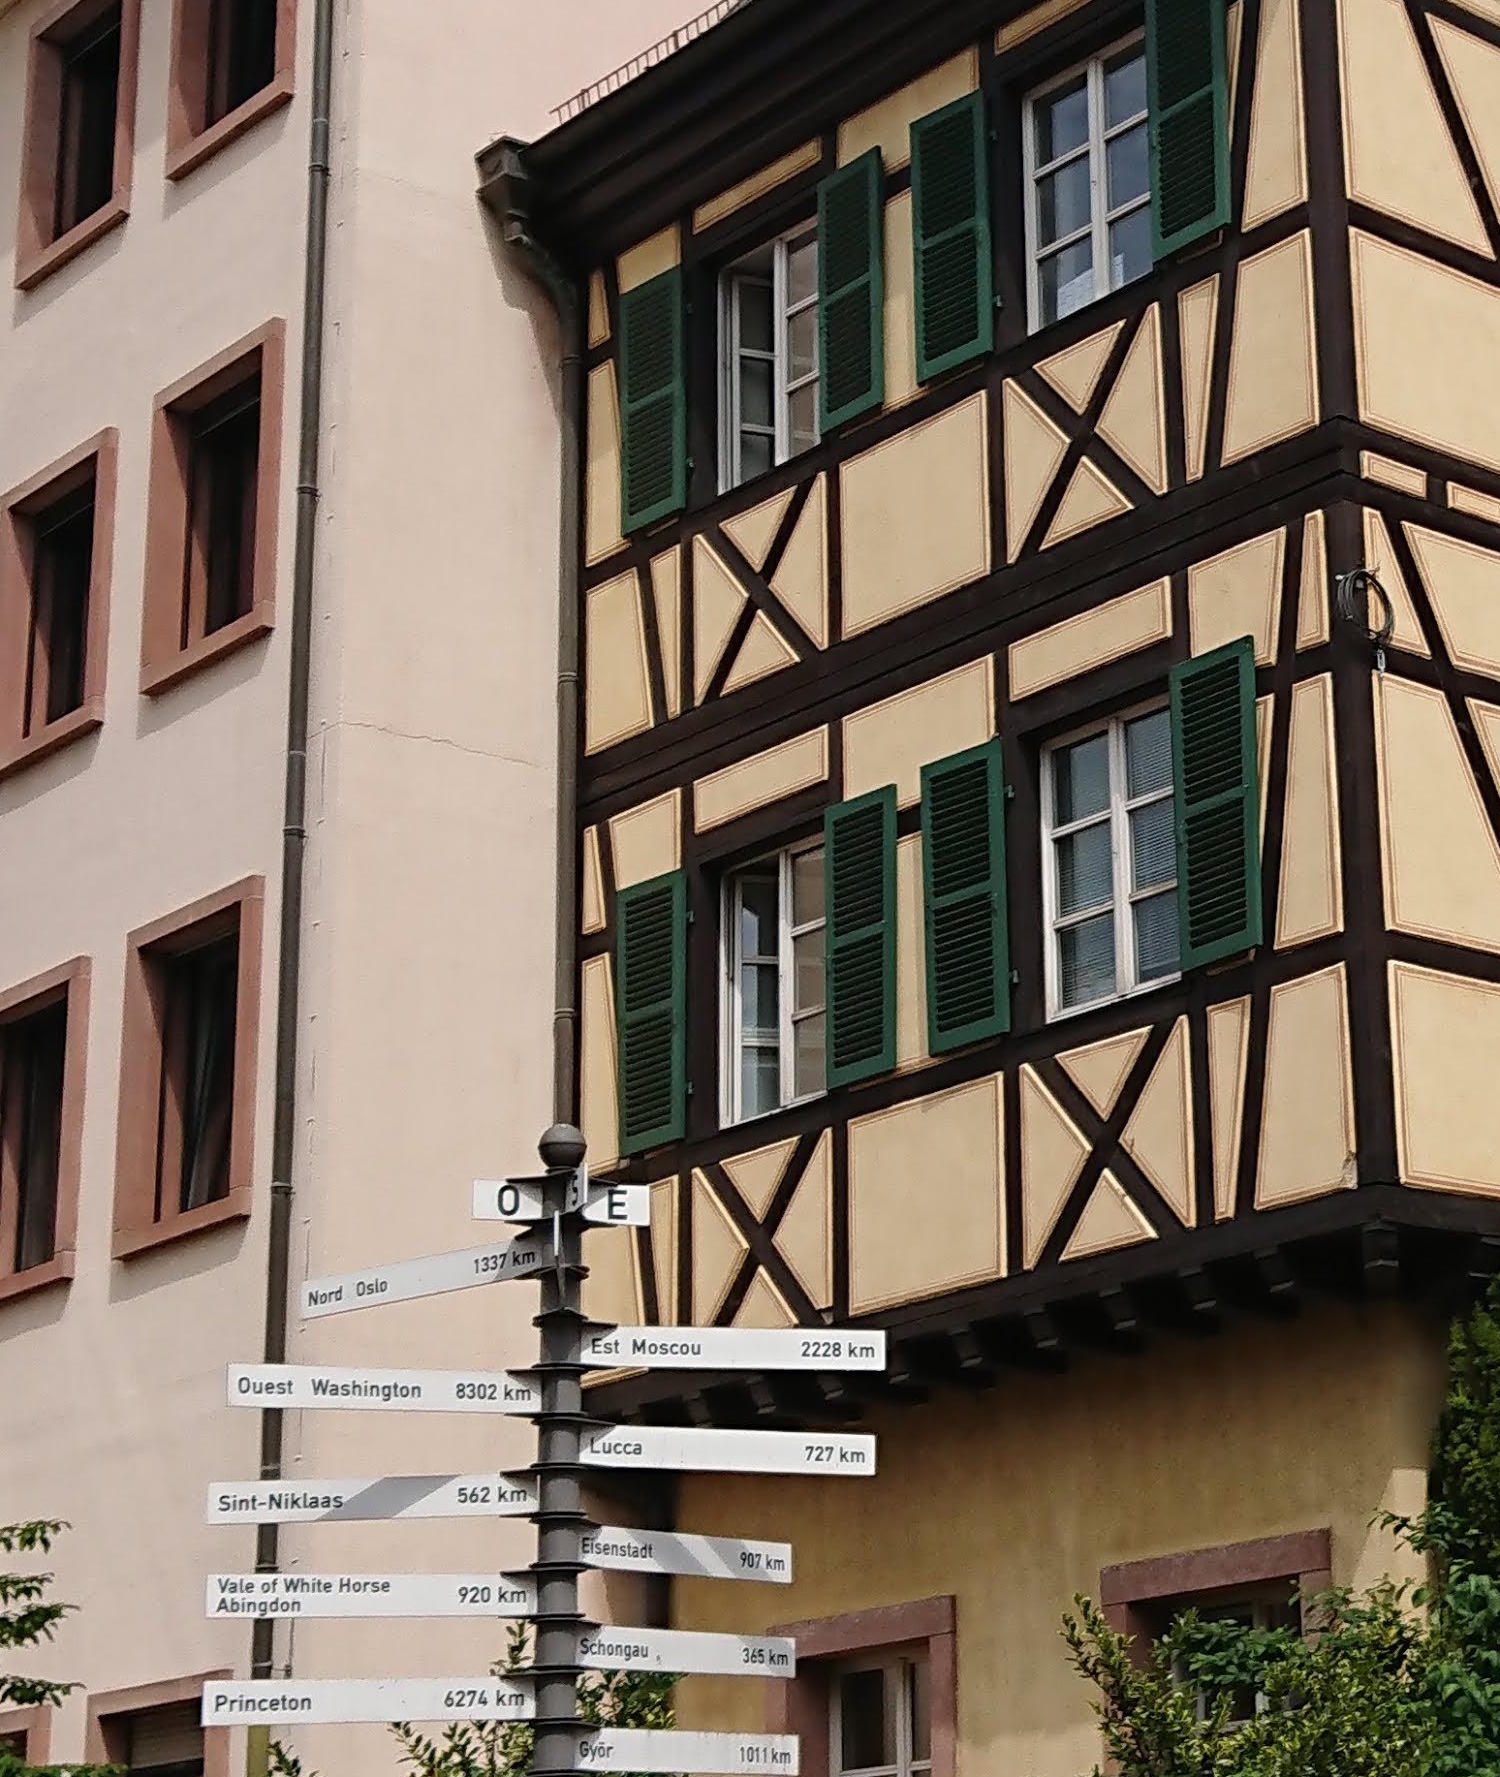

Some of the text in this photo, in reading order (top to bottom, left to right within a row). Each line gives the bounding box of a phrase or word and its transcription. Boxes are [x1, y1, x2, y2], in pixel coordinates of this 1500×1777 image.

[497, 1185, 520, 1216] O
[608, 1189, 628, 1220] E
[308, 1250, 536, 1307] Nord Oslo 1337 km
[591, 1338, 875, 1360] Est Moscou 2228 km
[238, 1377, 531, 1401] Ouest Washington 8302 km
[590, 1437, 866, 1463] Lucca 727 km
[218, 1486, 527, 1512] Sint-Niklaas 562 km
[582, 1537, 785, 1571] Eisenstadt 907 km
[217, 1577, 391, 1594] Vale of White Horse
[458, 1586, 527, 1604] 920 km
[216, 1598, 301, 1617] Abingdon
[580, 1638, 789, 1666] Schongau 365 km
[214, 1689, 525, 1712] Princeton 6274 km
[740, 1746, 768, 1763] 1011
[771, 1748, 792, 1764] km
